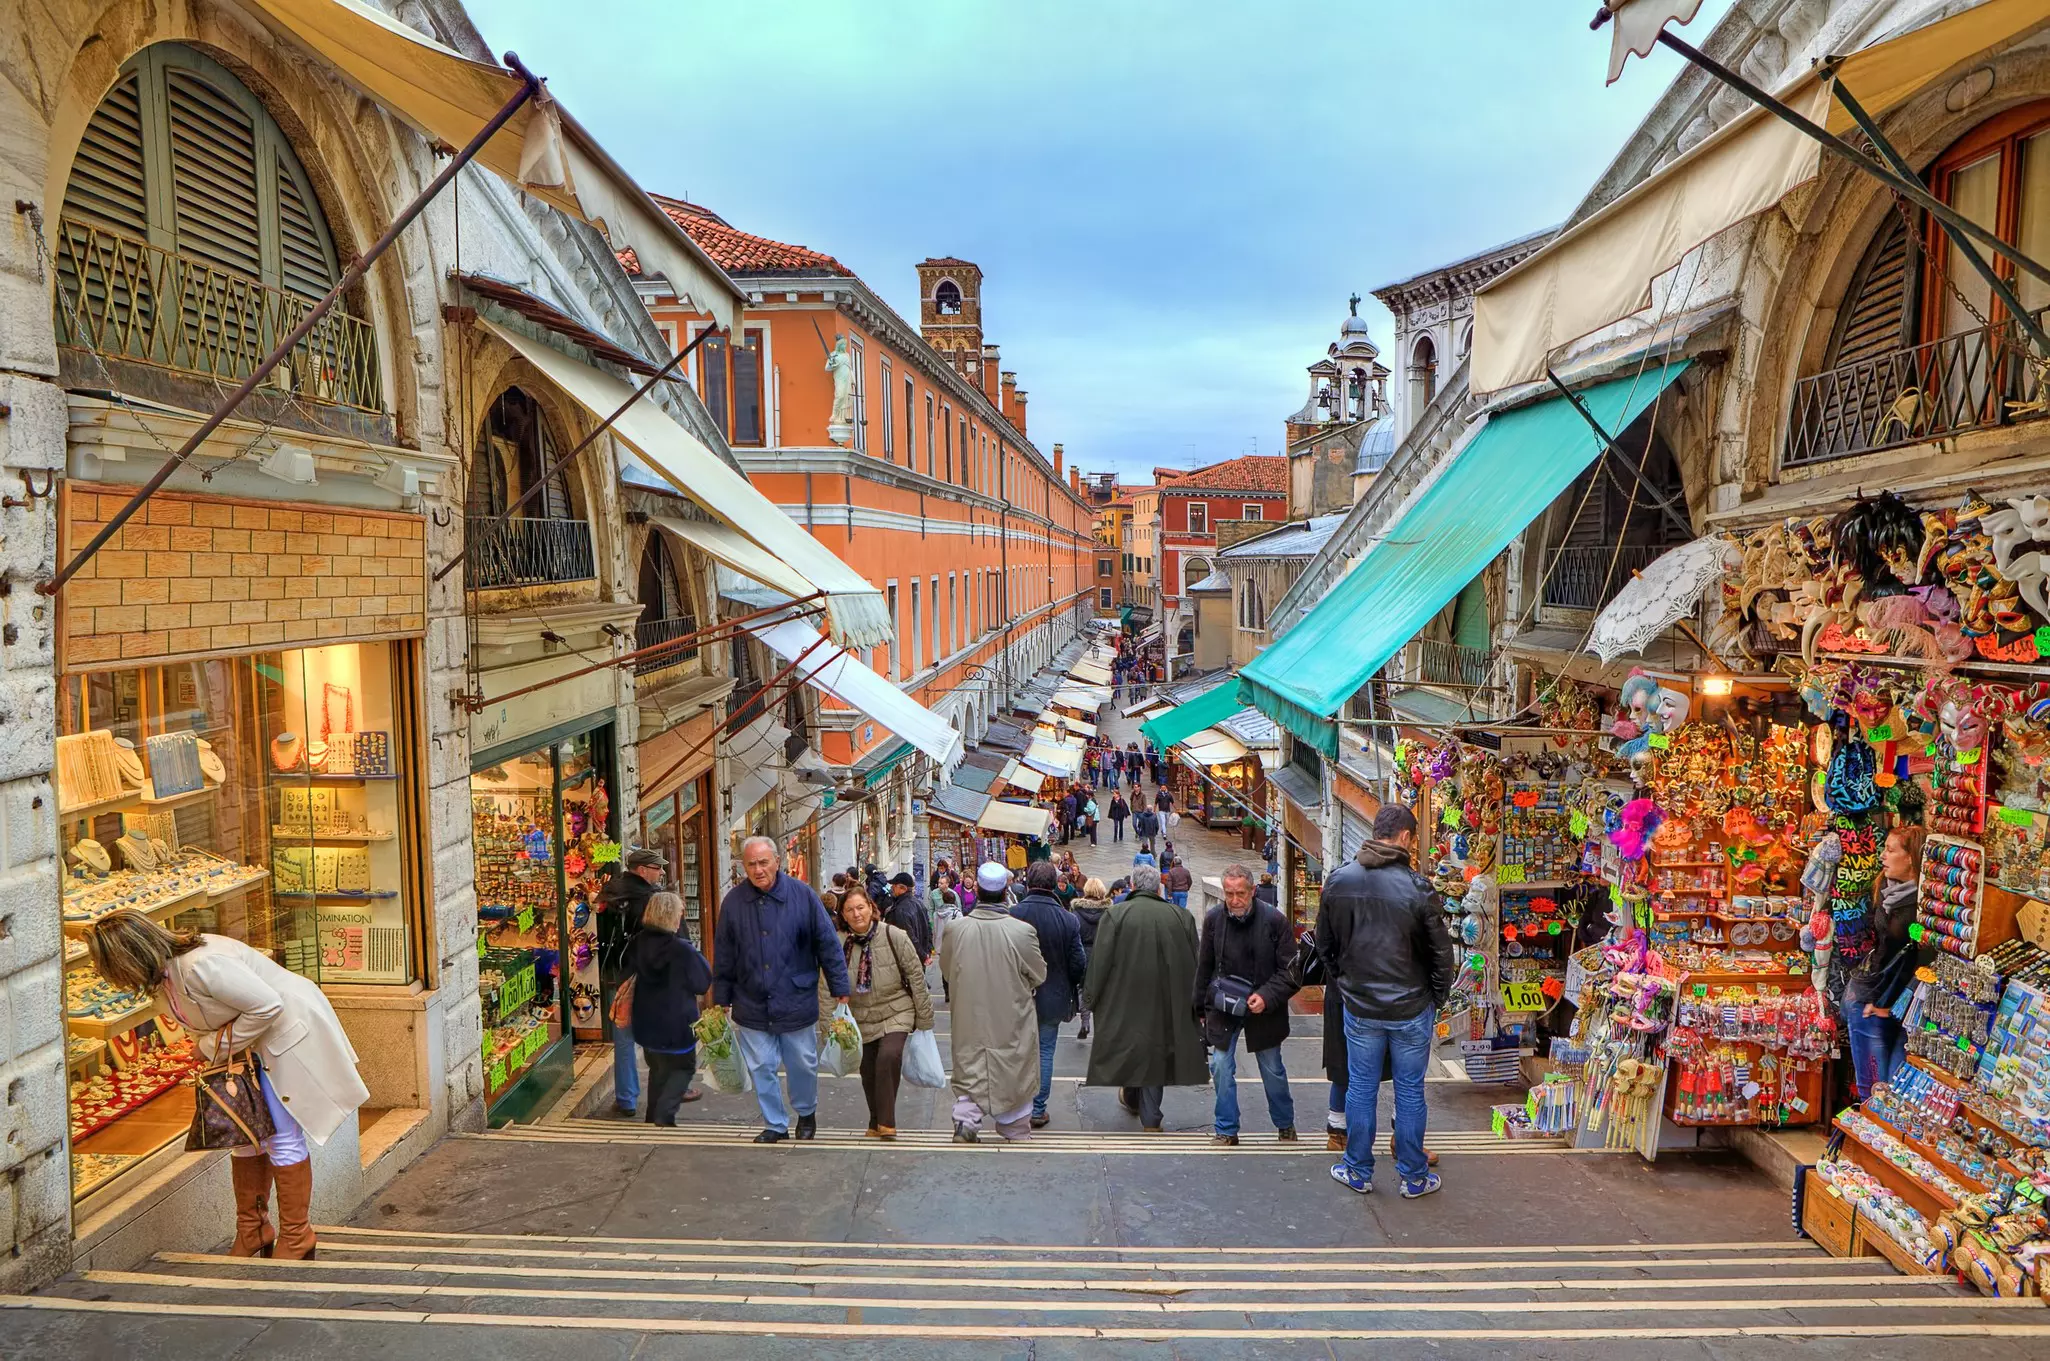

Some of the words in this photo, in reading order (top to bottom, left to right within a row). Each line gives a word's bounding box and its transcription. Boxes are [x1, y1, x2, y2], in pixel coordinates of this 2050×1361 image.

[305, 911, 372, 924] NOMINATION
[502, 987, 519, 1013] 1,00
[1504, 986, 1542, 1009] 1,00
